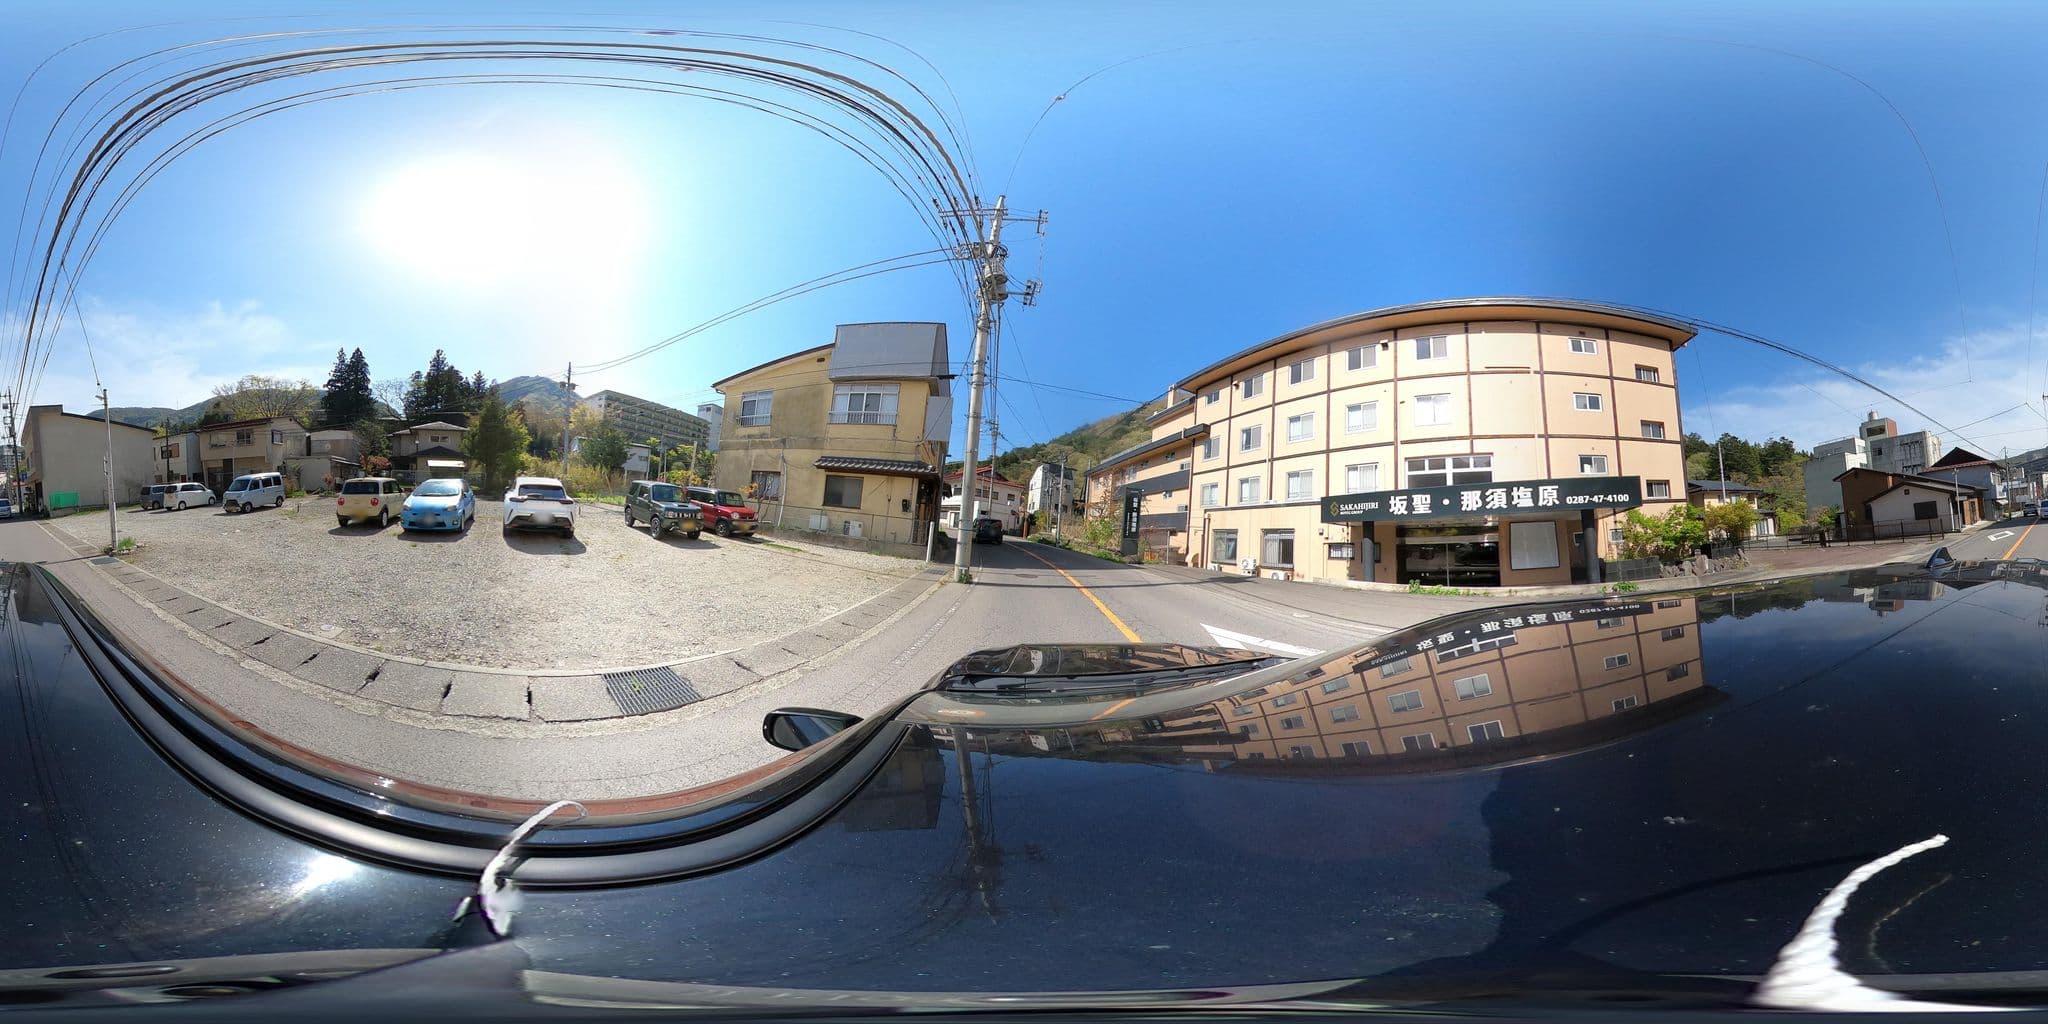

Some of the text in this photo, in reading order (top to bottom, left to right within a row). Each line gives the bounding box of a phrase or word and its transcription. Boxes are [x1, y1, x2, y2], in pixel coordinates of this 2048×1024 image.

[1389, 485, 1560, 515] 坂聖・那須塩原
[1566, 493, 1630, 505] 0287-47-4100
